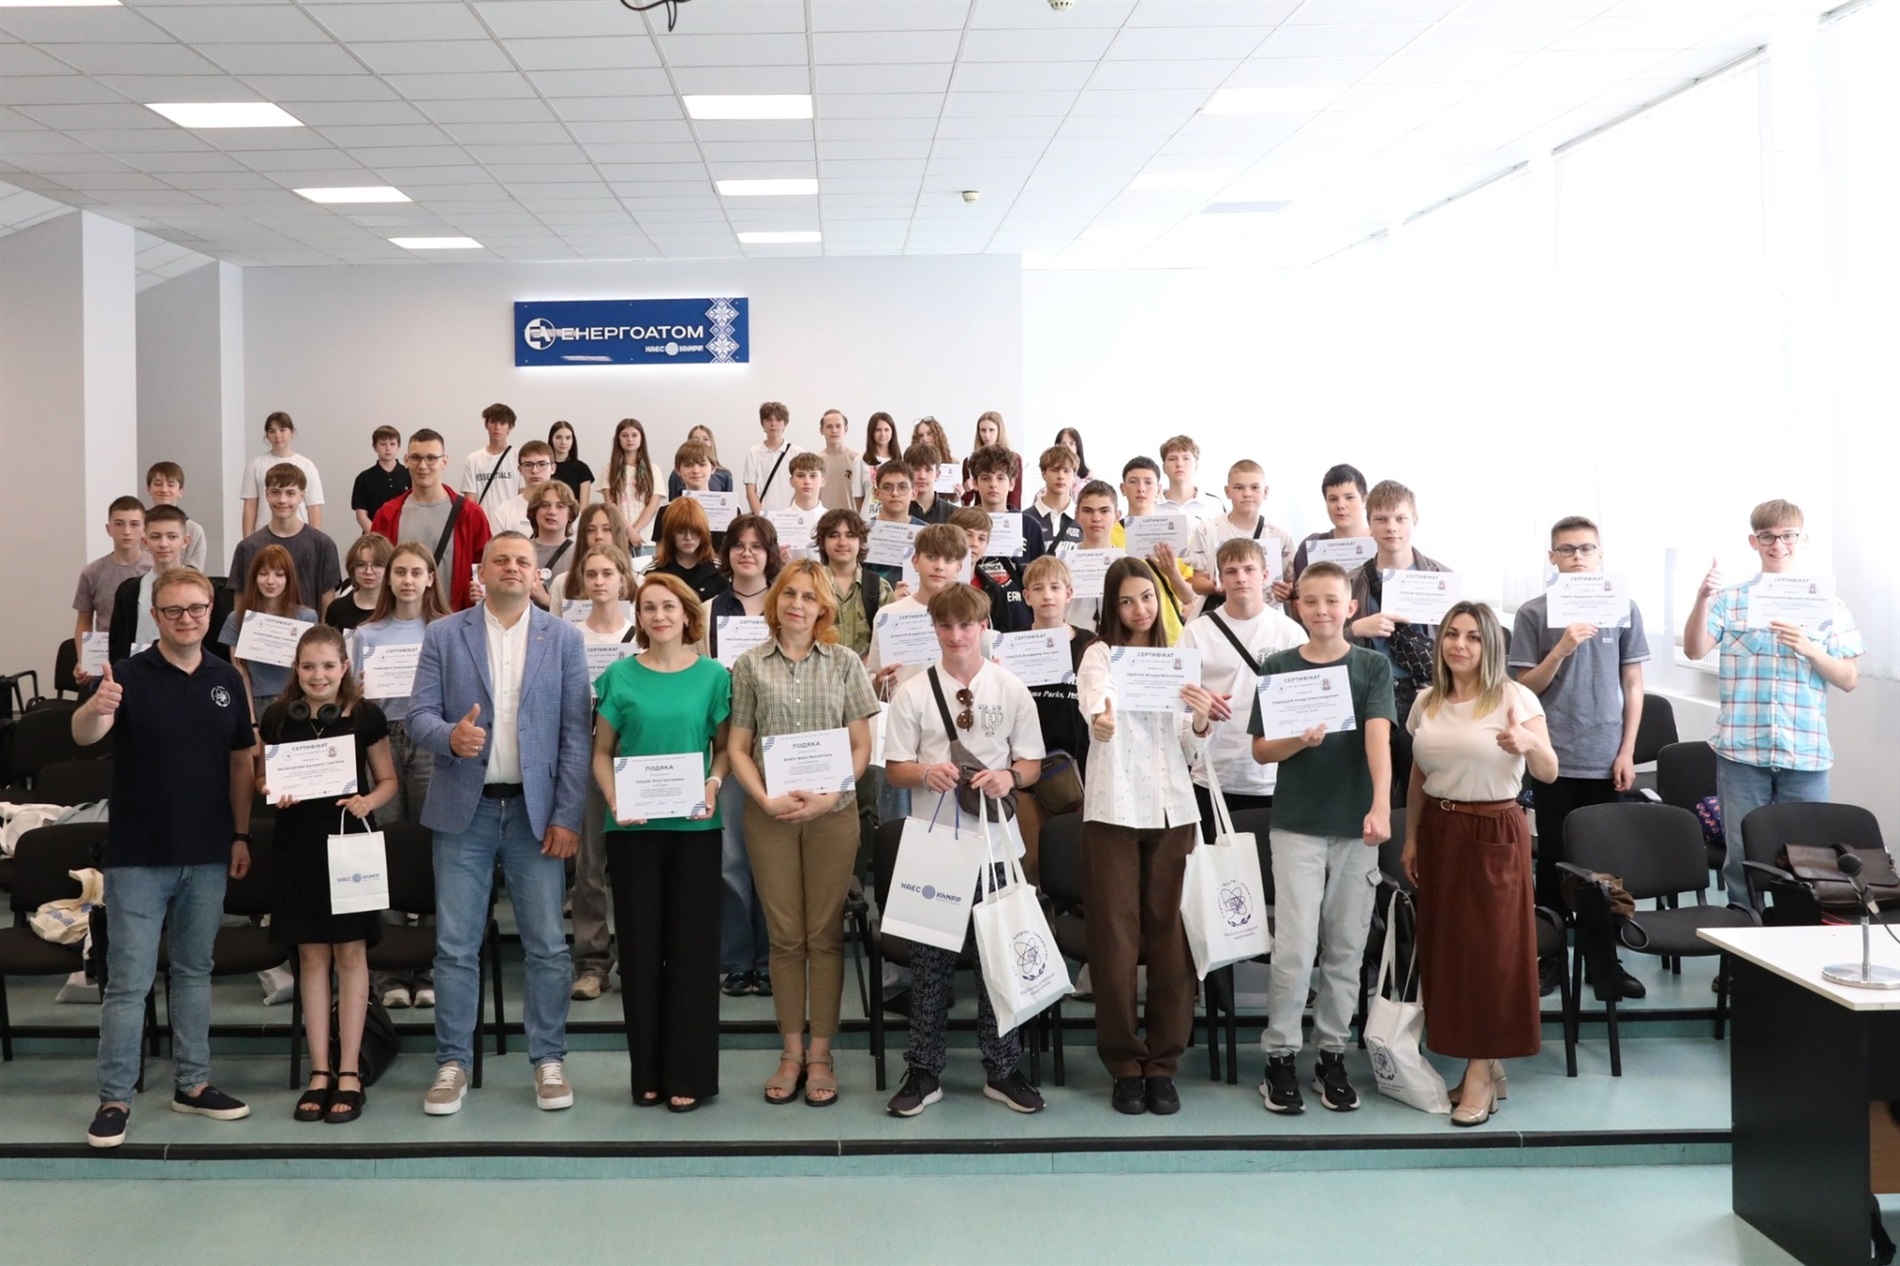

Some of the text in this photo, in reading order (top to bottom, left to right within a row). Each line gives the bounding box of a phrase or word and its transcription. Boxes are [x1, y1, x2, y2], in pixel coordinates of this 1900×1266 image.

[561, 325, 704, 341] ЕНЕРГОАТОМ
[476, 471, 512, 481] ESSETIALS
[1015, 633, 1046, 641] СЕРТИФІКАТ
[1284, 674, 1320, 683] СЕРТИФІКАТ
[1043, 690, 1065, 699] Parks,
[291, 742, 328, 752] СЕРТИФІКАТ
[792, 740, 821, 749] ПОДЯКА
[645, 764, 674, 772] ПОДЯКА
[936, 891, 962, 902] KhNPP
